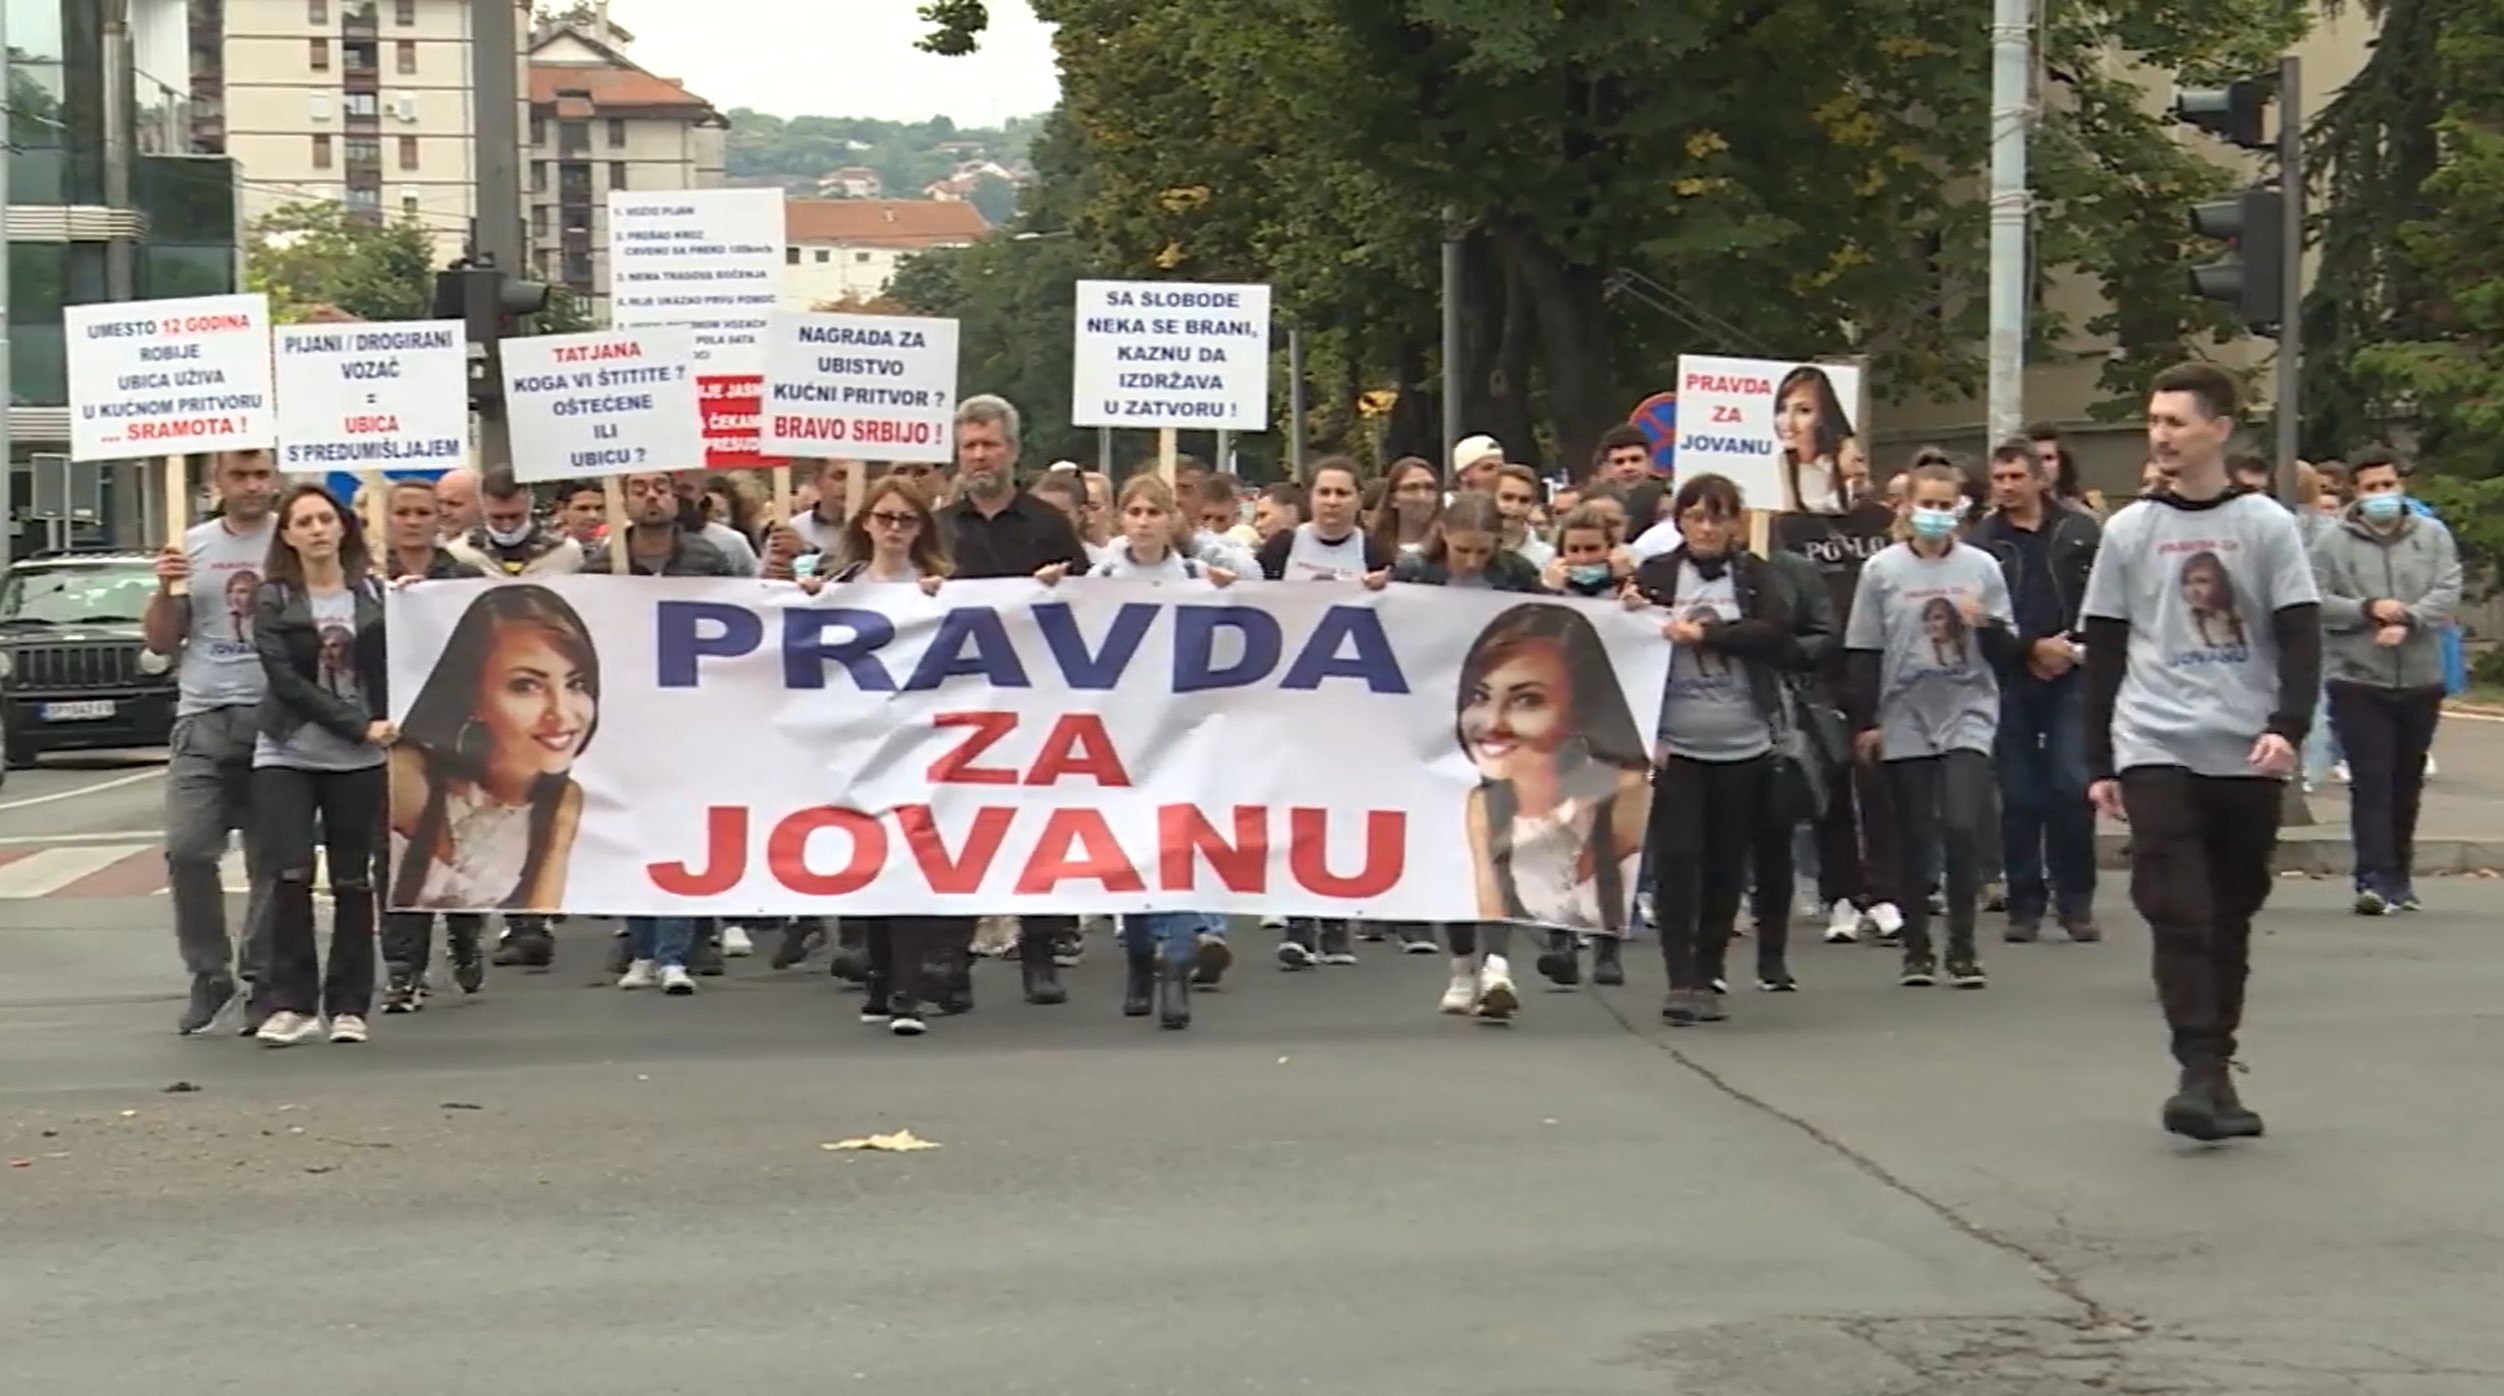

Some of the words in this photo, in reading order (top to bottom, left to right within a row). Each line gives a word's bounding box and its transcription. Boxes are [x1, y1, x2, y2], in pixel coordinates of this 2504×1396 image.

[673, 246, 687, 255] SA
[1106, 291, 1134, 306] SA
[1140, 291, 1240, 308] SLOBODE
[87, 320, 157, 339] UMESTO
[161, 318, 181, 334] 12
[185, 314, 250, 332] GODINA
[799, 326, 893, 347] NAGRADA
[899, 330, 926, 348] ZA
[1087, 318, 1145, 333] NEKA
[1152, 319, 1179, 334] SE
[1185, 320, 1258, 338] BRANI,
[285, 335, 343, 353] PIJANI
[356, 330, 453, 351] DROGIRANI
[552, 341, 642, 363] TATJANA
[139, 344, 201, 362] ROBIJE
[1117, 346, 1191, 362] KAZNU
[1199, 348, 1226, 363] DA
[341, 356, 401, 379] VOZAČ
[817, 356, 905, 377] UBISTVO
[117, 373, 170, 390] UBICA
[174, 368, 225, 386] UŽIVA
[514, 374, 569, 393] KOGA
[573, 372, 592, 388] VI
[597, 366, 671, 387] ŠTITITE
[1119, 370, 1223, 390] IZDRŽAVA
[1685, 373, 1772, 395] PRAVDA
[552, 394, 653, 416] OŠTEĆENE
[773, 381, 837, 403] KUĆNI
[843, 386, 929, 407] PRITVOR
[934, 391, 946, 408] ?
[83, 404, 95, 419] U
[99, 397, 174, 417] KUĆNOM
[178, 394, 263, 412] PRITVORU
[1104, 400, 1119, 415] U
[1124, 401, 1225, 417] ZATVORU
[1711, 405, 1742, 423] ZA
[127, 417, 235, 441] SRAMOTA
[344, 415, 400, 434] UBICA
[593, 423, 618, 439] ILI
[774, 415, 846, 440] BRAVO
[852, 419, 930, 444] SRBIJO
[1679, 434, 1772, 456] JOVANU
[571, 448, 631, 467] UBICU
[635, 447, 646, 463] ?
[656, 600, 1411, 695] PRAVDA
[926, 710, 1133, 788] ZA
[645, 802, 1407, 899] JOVANU
